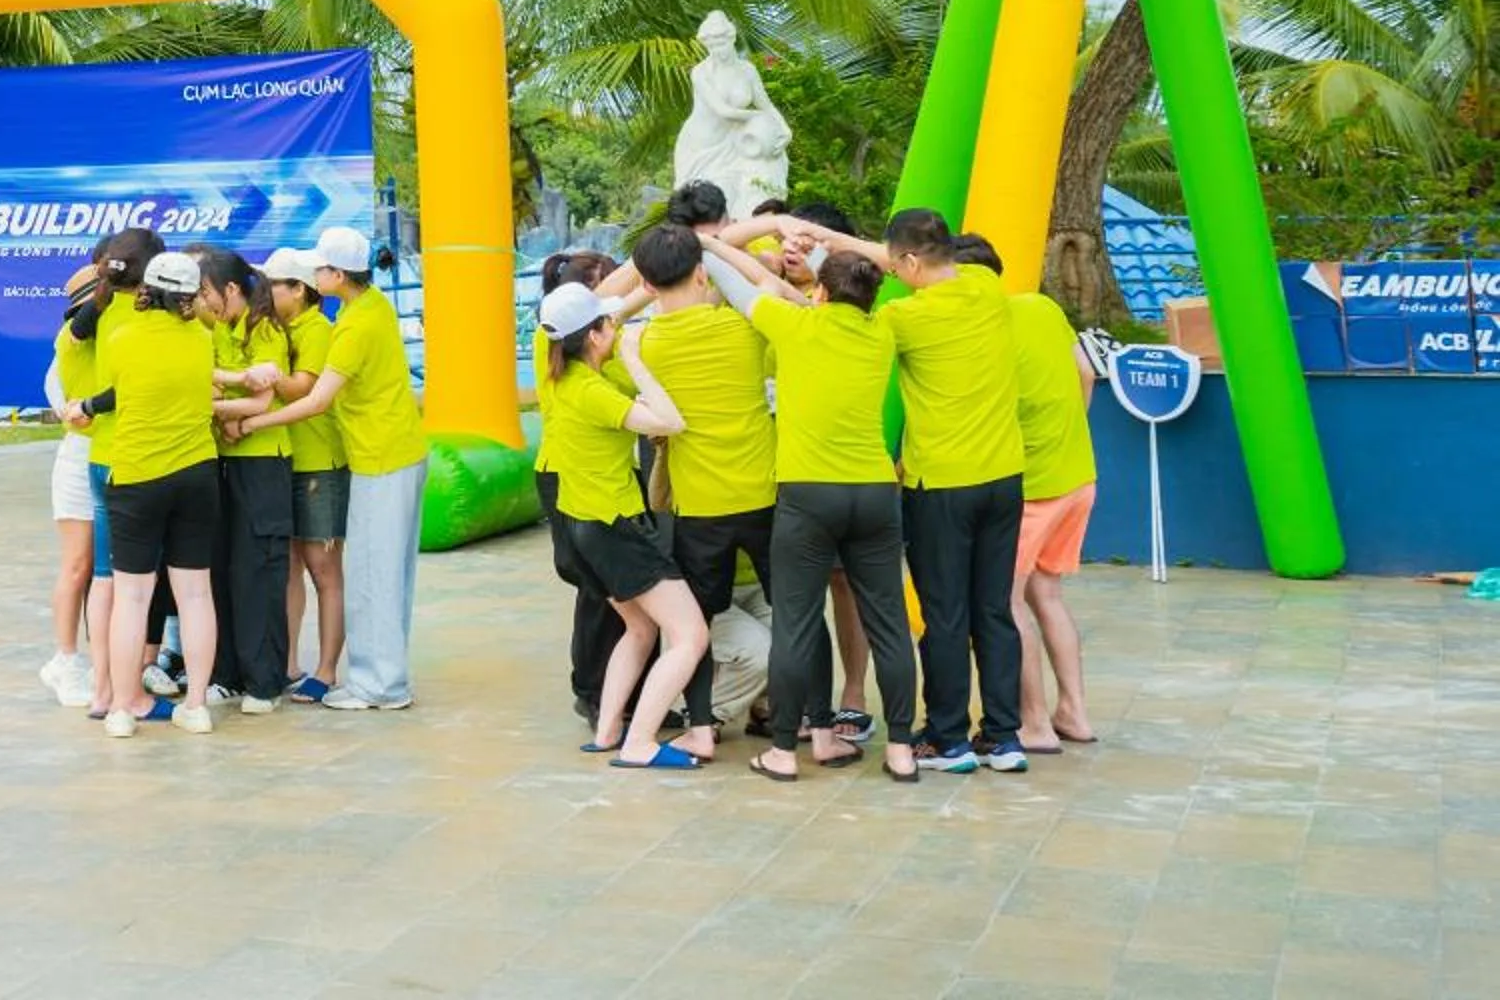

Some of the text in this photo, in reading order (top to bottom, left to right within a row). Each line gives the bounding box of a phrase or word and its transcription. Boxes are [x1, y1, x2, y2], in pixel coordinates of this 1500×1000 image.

[255, 80, 297, 98] LONG
[300, 75, 345, 97] QUÂN
[158, 206, 233, 233] 2024
[1419, 332, 1470, 351] ACB
[1129, 371, 1179, 389] TEAM 1
